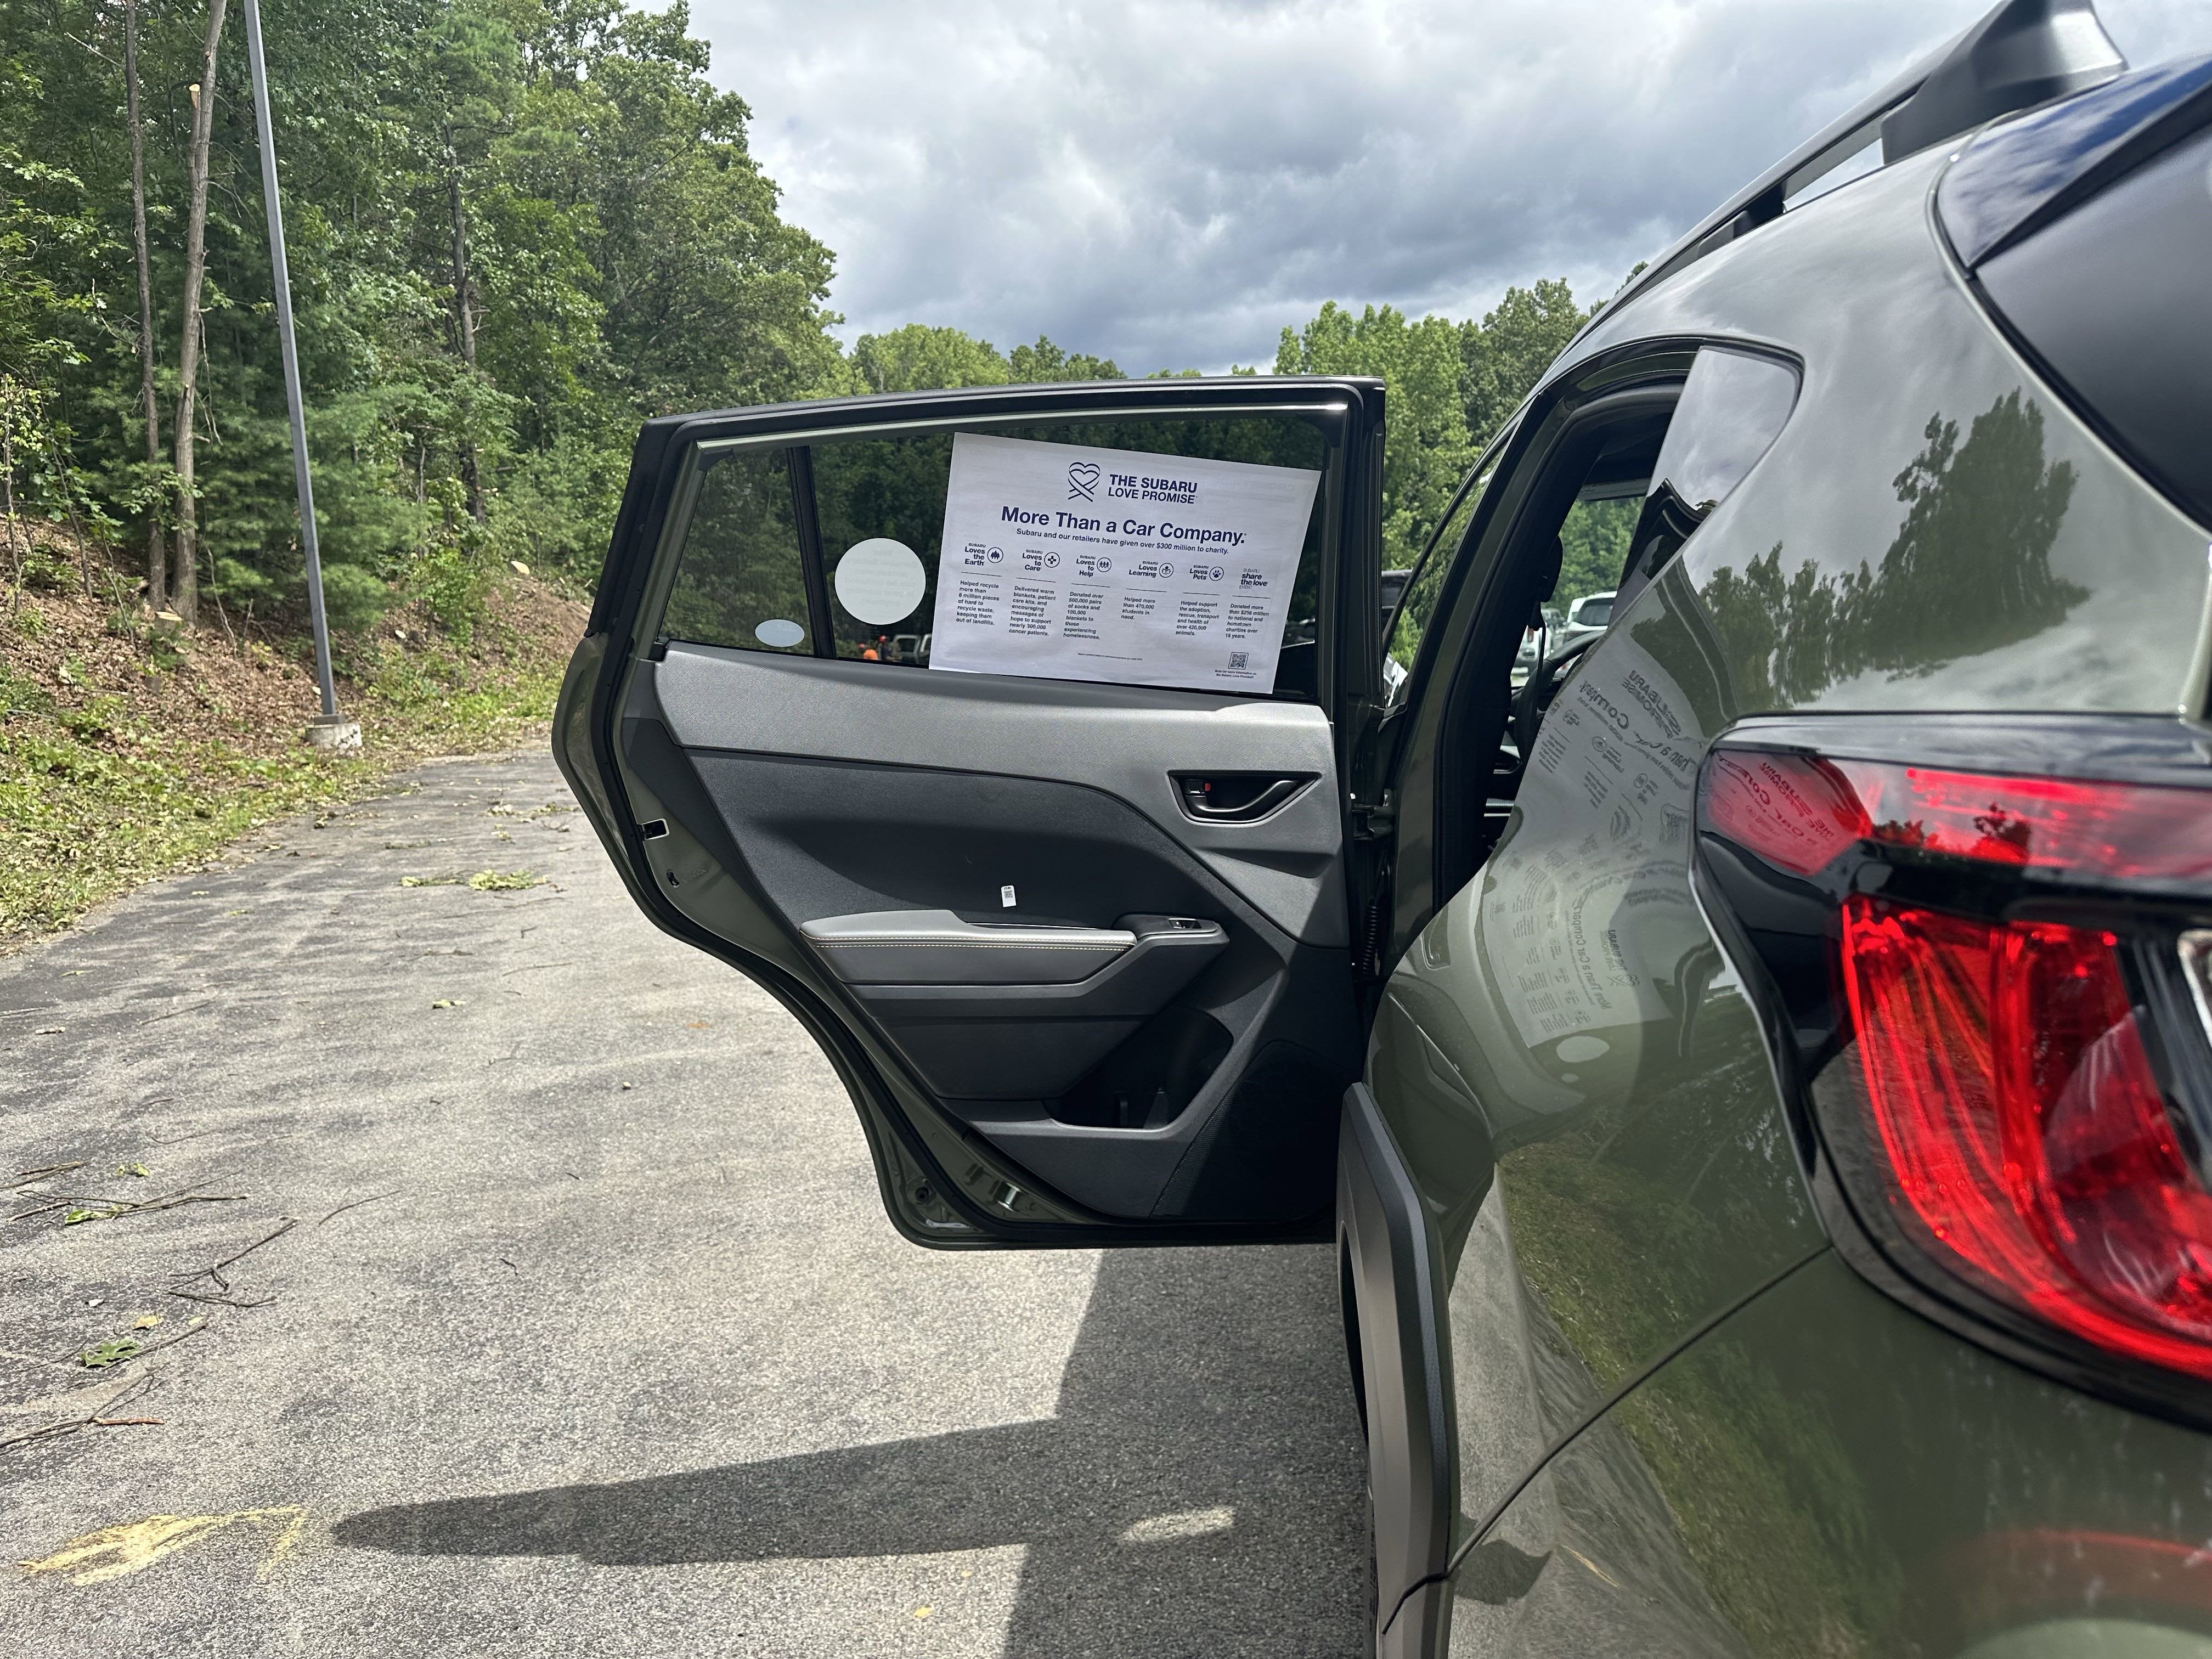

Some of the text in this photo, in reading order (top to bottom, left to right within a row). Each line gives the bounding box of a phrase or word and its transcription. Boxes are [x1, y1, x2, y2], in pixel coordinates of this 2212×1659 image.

[1109, 473, 1198, 493] THE SUBARU
[1108, 487, 1195, 504] LOVE PROMISE
[1001, 506, 1049, 526] More
[1056, 511, 1101, 531] Than
[1105, 521, 1117, 533] a
[1122, 519, 1155, 537] Car
[1016, 528, 1042, 537] Subaru
[1072, 535, 1100, 543] retailers
[1205, 546, 1228, 555] charity.
[964, 546, 985, 554] Loves
[1022, 552, 1042, 561] Loves
[964, 558, 985, 566] Earth
[1079, 569, 1094, 578] Help
[1128, 569, 1157, 578] Learning
[1011, 604, 1045, 613] encouraging
[956, 611, 978, 619] keeping
